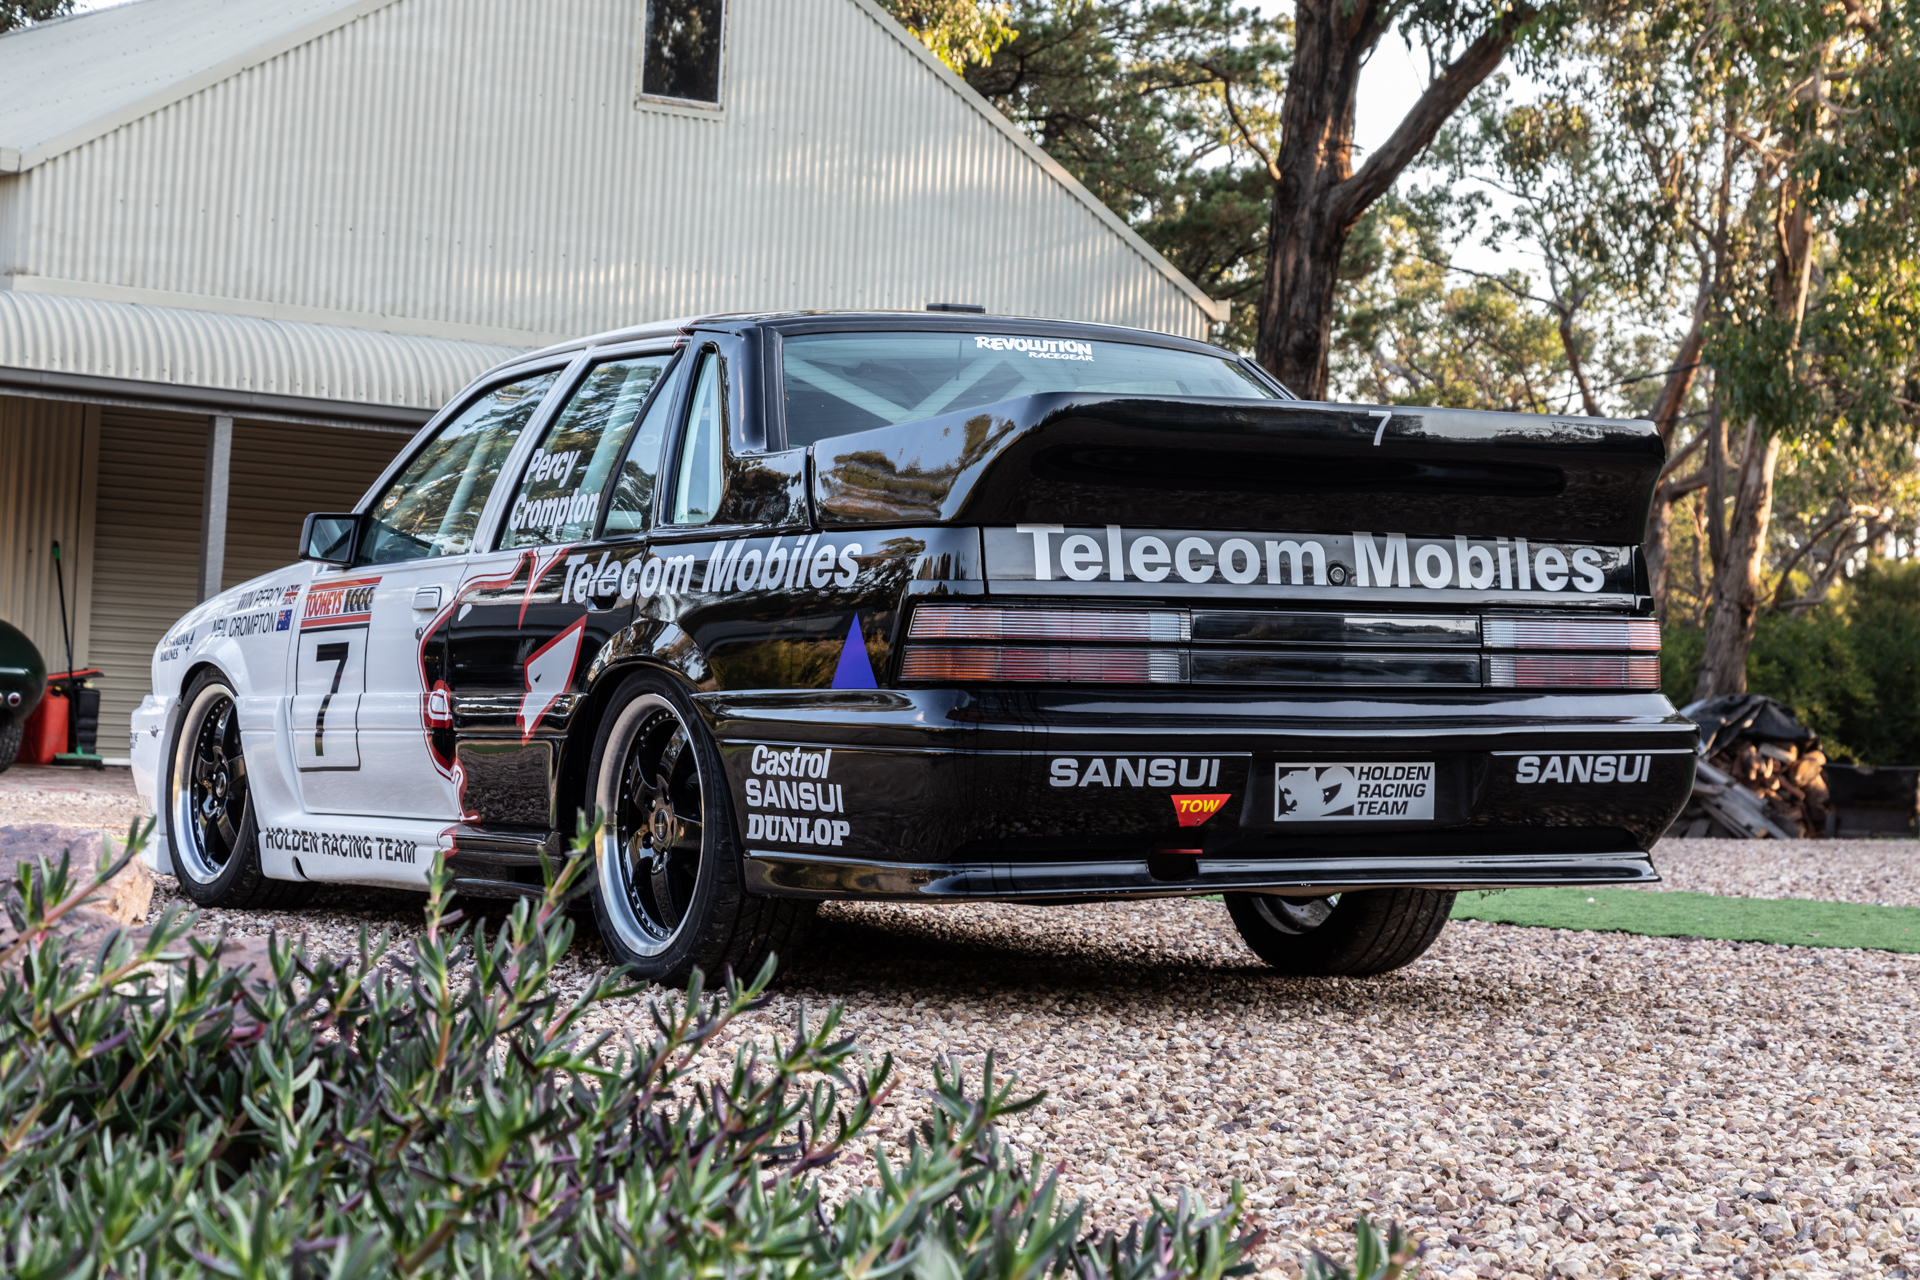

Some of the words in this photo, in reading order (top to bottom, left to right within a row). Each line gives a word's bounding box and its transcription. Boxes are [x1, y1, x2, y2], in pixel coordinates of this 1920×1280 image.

[974, 336, 1093, 355] REVOLUTION
[1028, 351, 1095, 362] RACEGEAR
[1367, 410, 1393, 446] 7
[522, 448, 582, 489] Percy
[509, 487, 600, 537] Crompton
[560, 551, 695, 604] Telecom
[701, 533, 864, 593] Mobiles
[1016, 523, 1327, 586] Telecom
[1353, 531, 1605, 592] Mobiles
[236, 590, 256, 611] WIN
[253, 586, 286, 608] PERCY
[303, 589, 345, 618] TOOHEYS
[210, 618, 228, 638] NEIL
[228, 612, 277, 638] CROMPTON
[315, 641, 350, 757] 7
[750, 744, 832, 779] Castrol
[1049, 757, 1221, 788] SANSUI
[1356, 765, 1430, 781] HOLDEN
[1515, 755, 1652, 784] SANSUI
[745, 778, 844, 813] SANSUI
[1356, 783, 1427, 798] RACING
[1179, 799, 1220, 814] TOW
[1356, 800, 1408, 815] TEAM
[265, 827, 319, 854] HOLDEN
[321, 831, 374, 860] RACING
[375, 836, 418, 864] TEAM
[745, 813, 851, 847] DUNLOP
